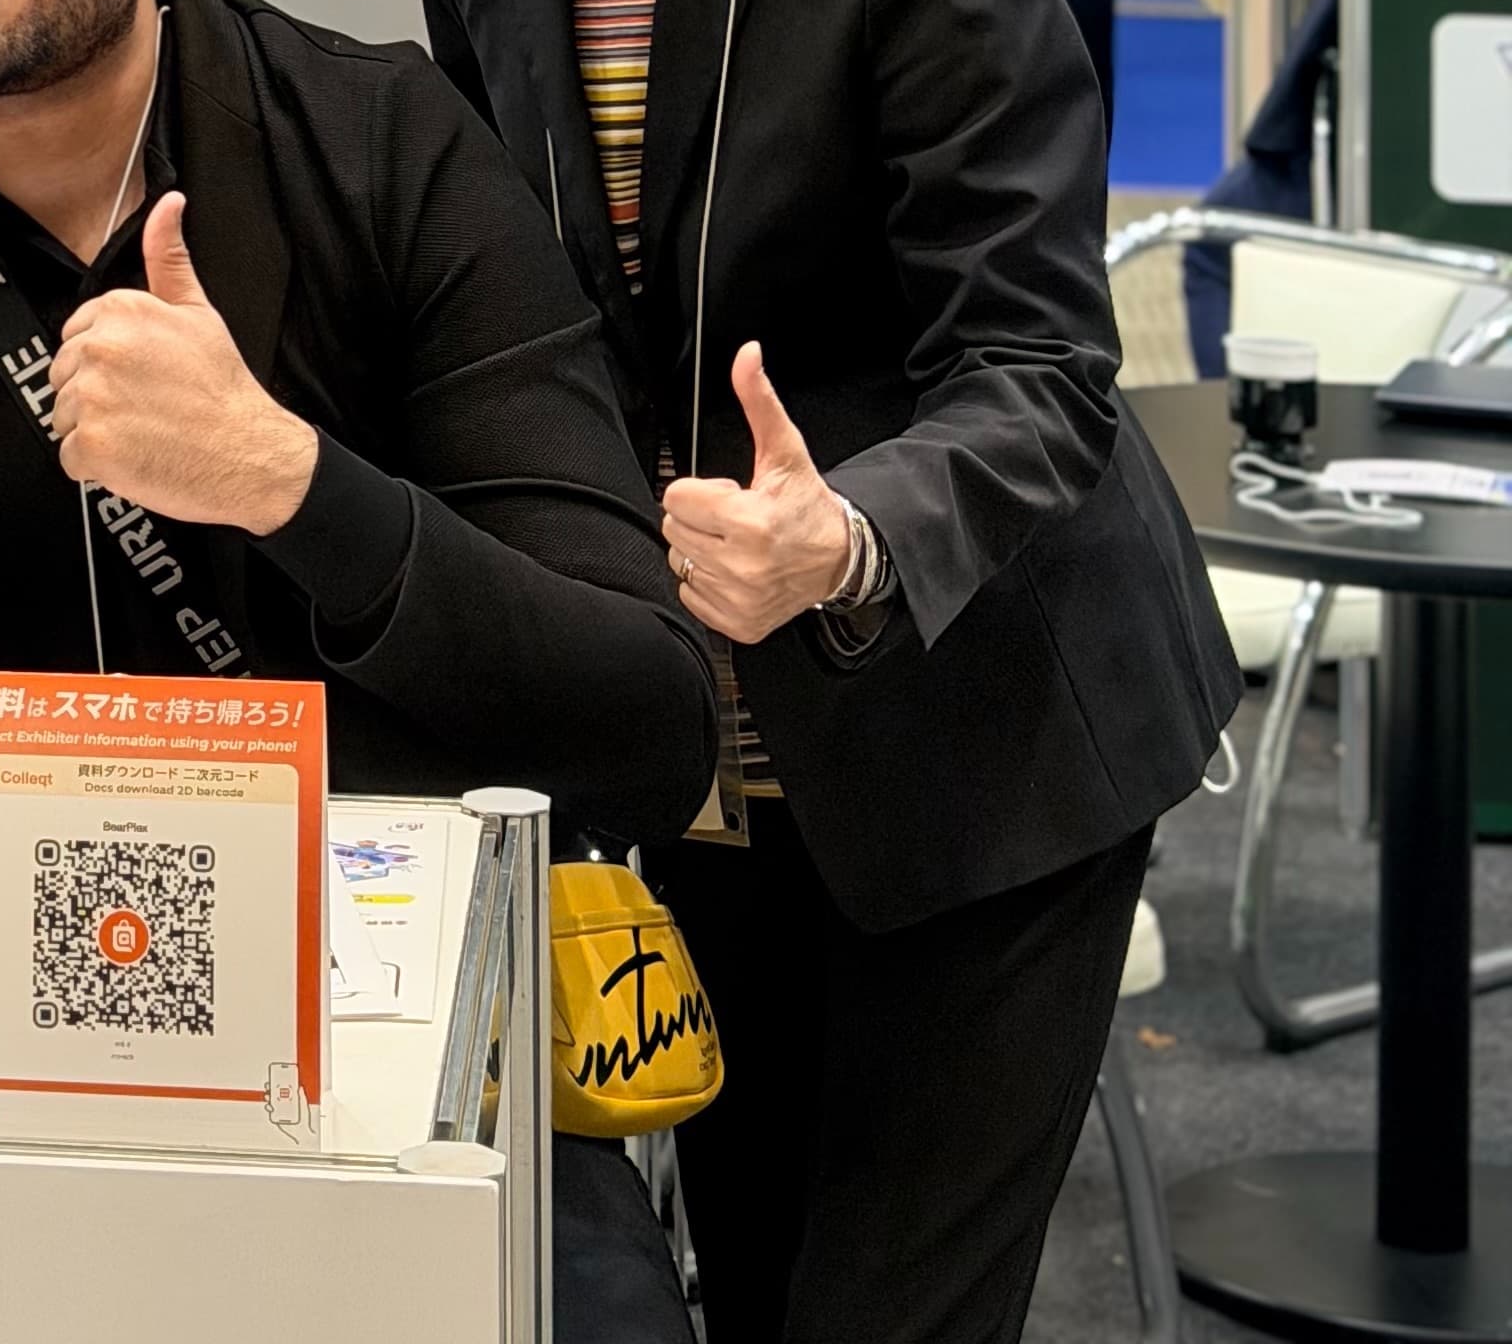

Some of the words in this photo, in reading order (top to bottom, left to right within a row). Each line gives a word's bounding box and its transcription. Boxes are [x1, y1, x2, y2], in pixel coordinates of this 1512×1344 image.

[16, 730, 81, 746] Exhibitor
[83, 733, 166, 748] Information
[171, 737, 209, 751] using
[211, 739, 244, 752] your
[247, 738, 298, 753] phone!
[0, 769, 54, 787] Colleqt
[78, 763, 179, 780] 資料ダウンロード
[183, 766, 260, 782] 二次元コード
[84, 782, 113, 794] Docs
[117, 783, 174, 796] download
[177, 785, 194, 796] 2D
[196, 785, 244, 798] barcode
